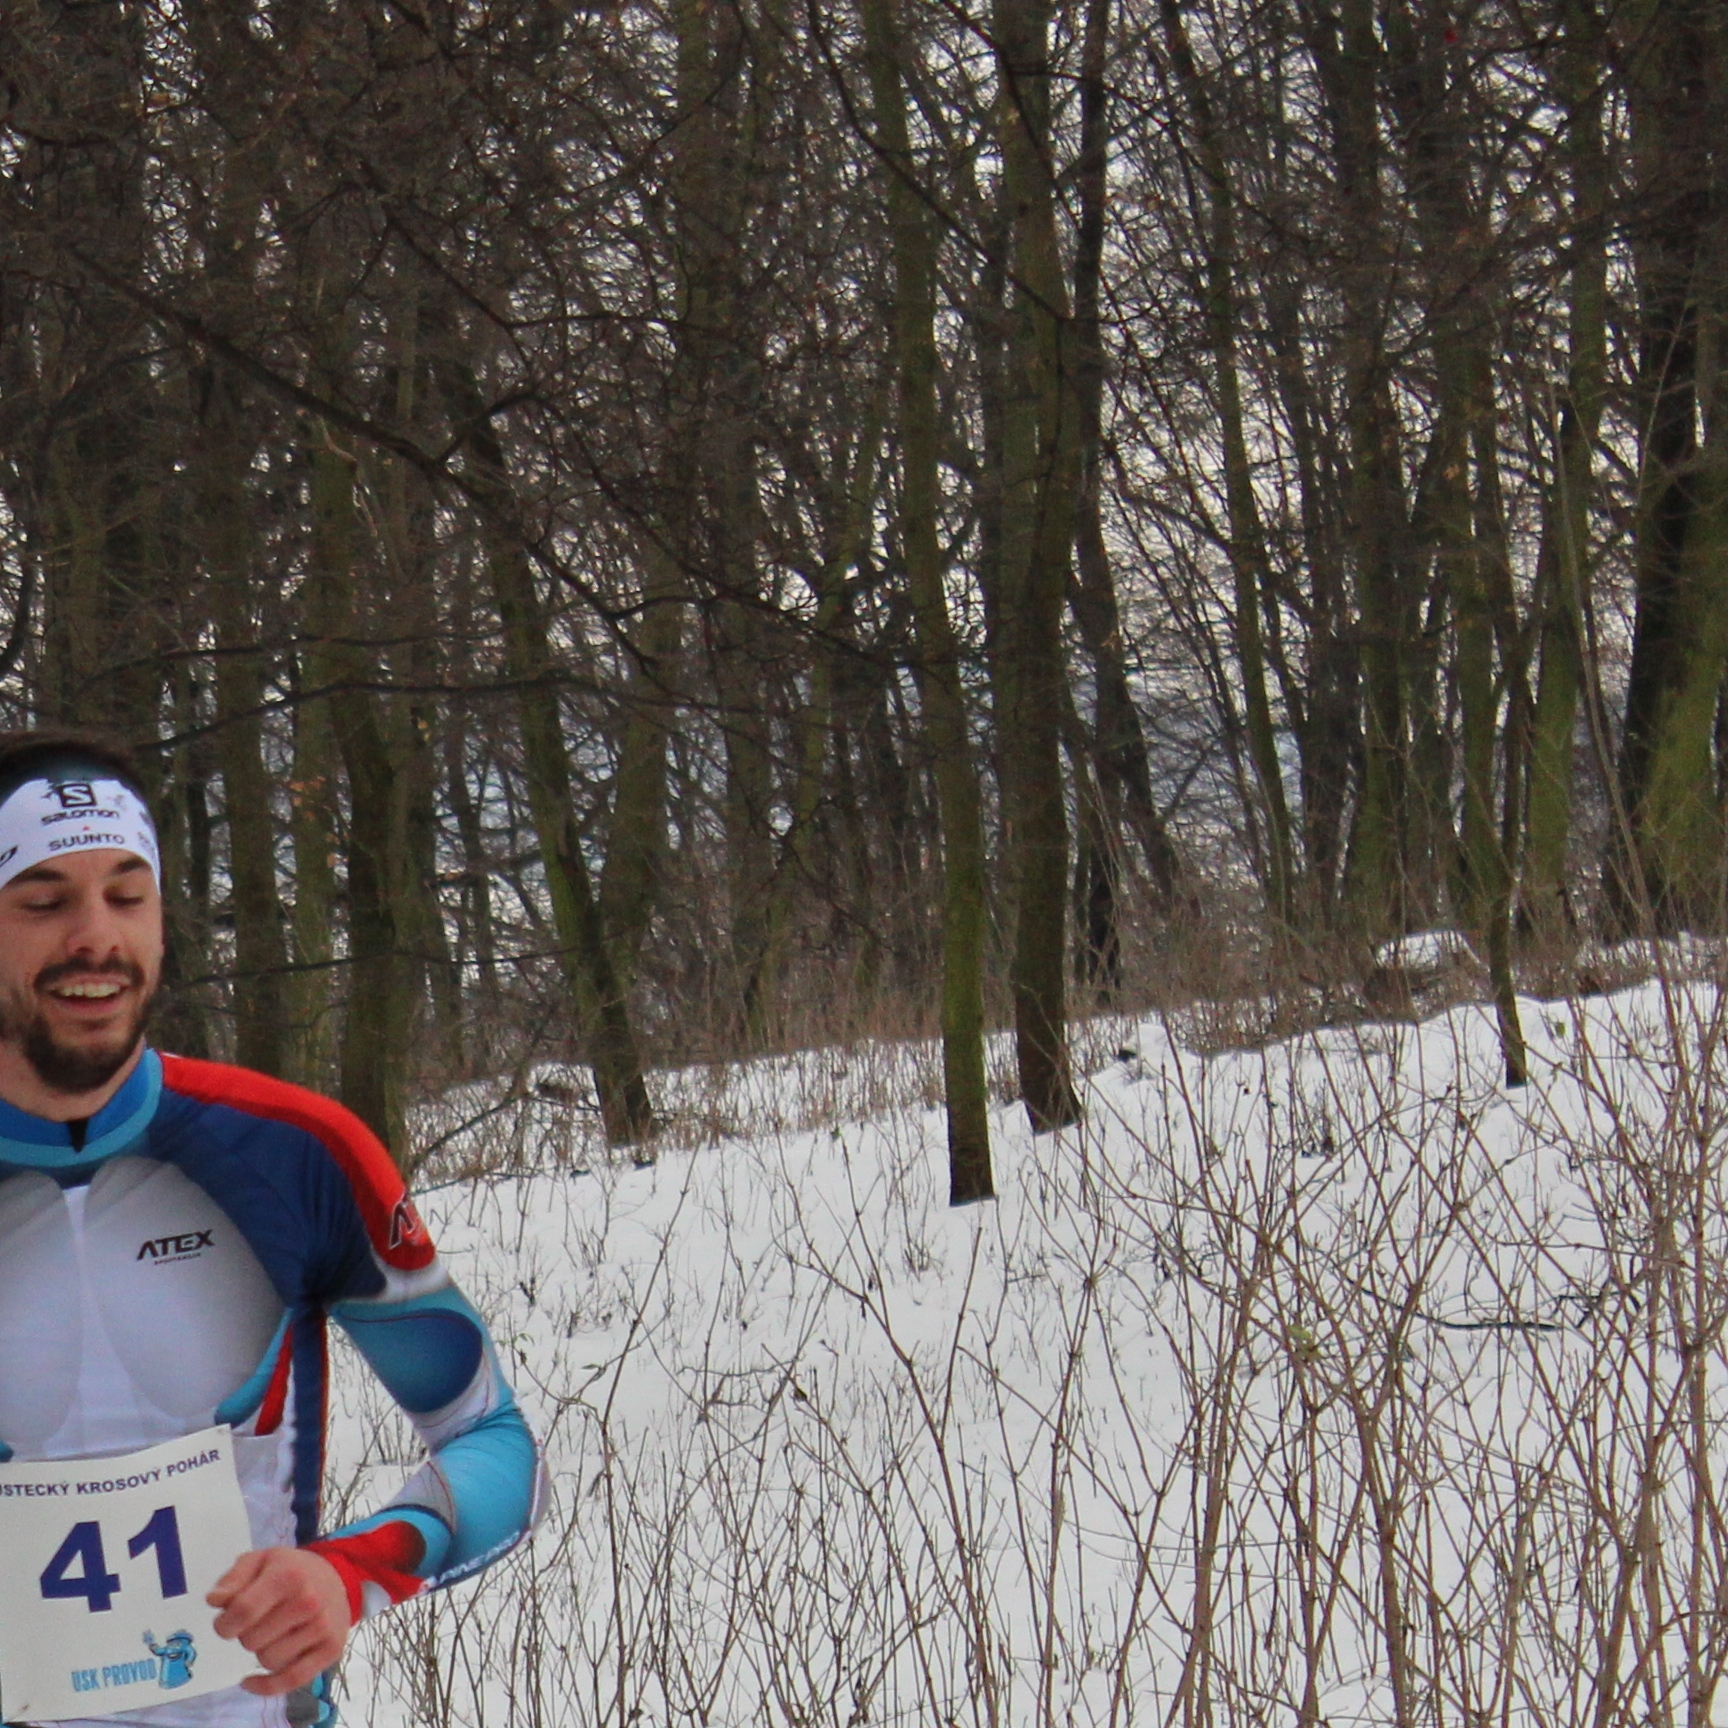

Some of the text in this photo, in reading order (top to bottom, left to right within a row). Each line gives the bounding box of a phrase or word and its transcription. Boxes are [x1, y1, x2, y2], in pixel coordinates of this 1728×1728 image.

[41, 808, 120, 827] salomon
[48, 833, 125, 851] SUUNTO
[137, 1229, 215, 1261] ATEX
[76, 1466, 162, 1495] KROSOVÝ
[166, 1449, 221, 1478] POHÁR
[40, 1505, 188, 1613] 41
[70, 1658, 158, 1692] USK PROVOD
